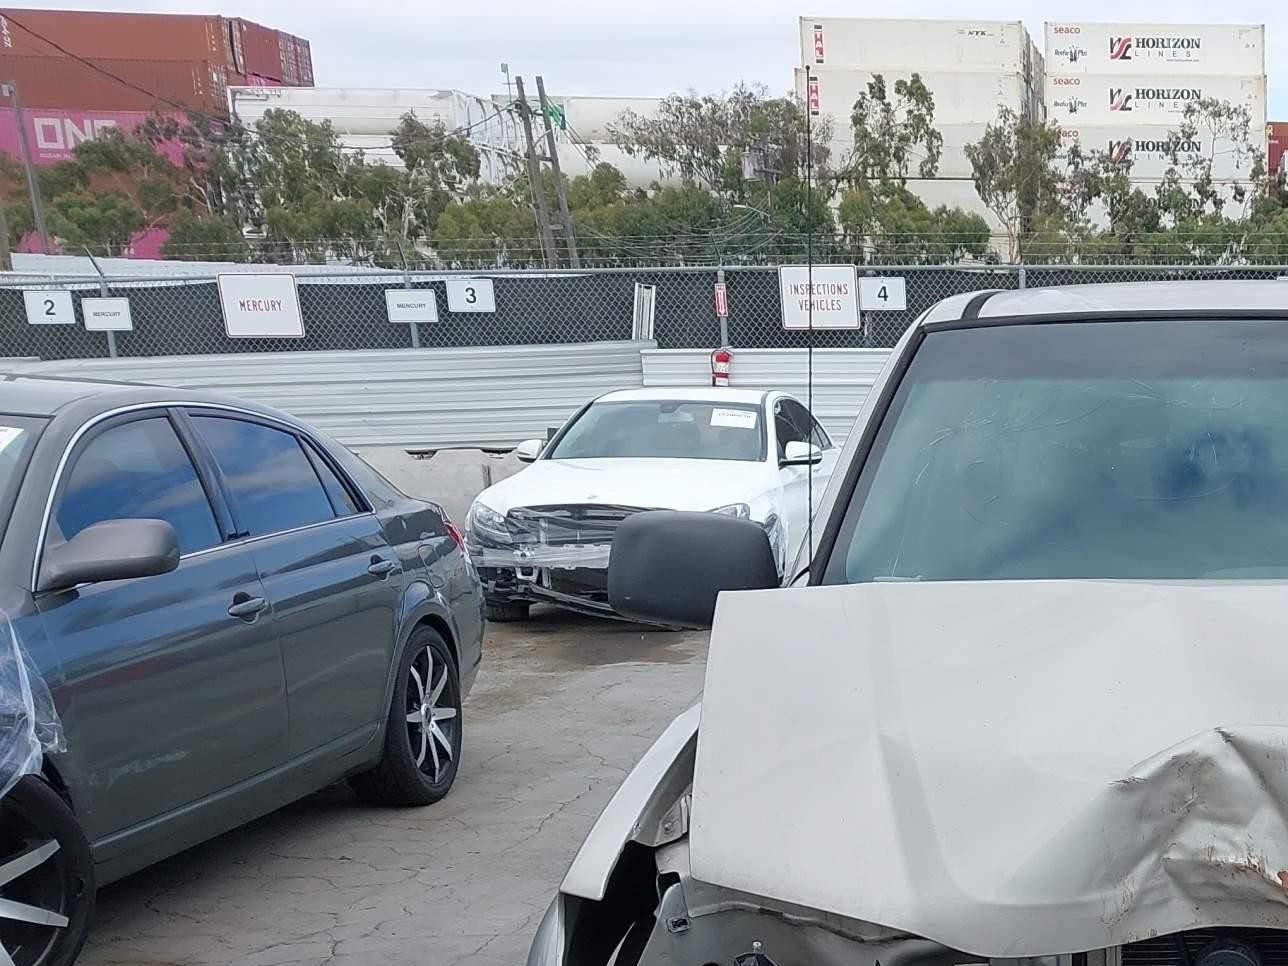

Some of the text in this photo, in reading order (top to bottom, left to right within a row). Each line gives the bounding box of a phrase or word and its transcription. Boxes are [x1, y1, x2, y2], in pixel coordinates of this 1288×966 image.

[1053, 26, 1081, 34] seaco
[1134, 37, 1201, 49] HORIZON
[1052, 78, 1081, 86] seaco
[1134, 88, 1202, 100] HORIZON
[1134, 153, 1193, 161] LINS
[790, 283, 849, 295] INSPECTIONS
[877, 285, 889, 302] 4
[464, 287, 477, 304] 3
[43, 299, 56, 316] 2
[239, 300, 283, 312] MERCURY
[799, 300, 842, 311] VEHICLES
